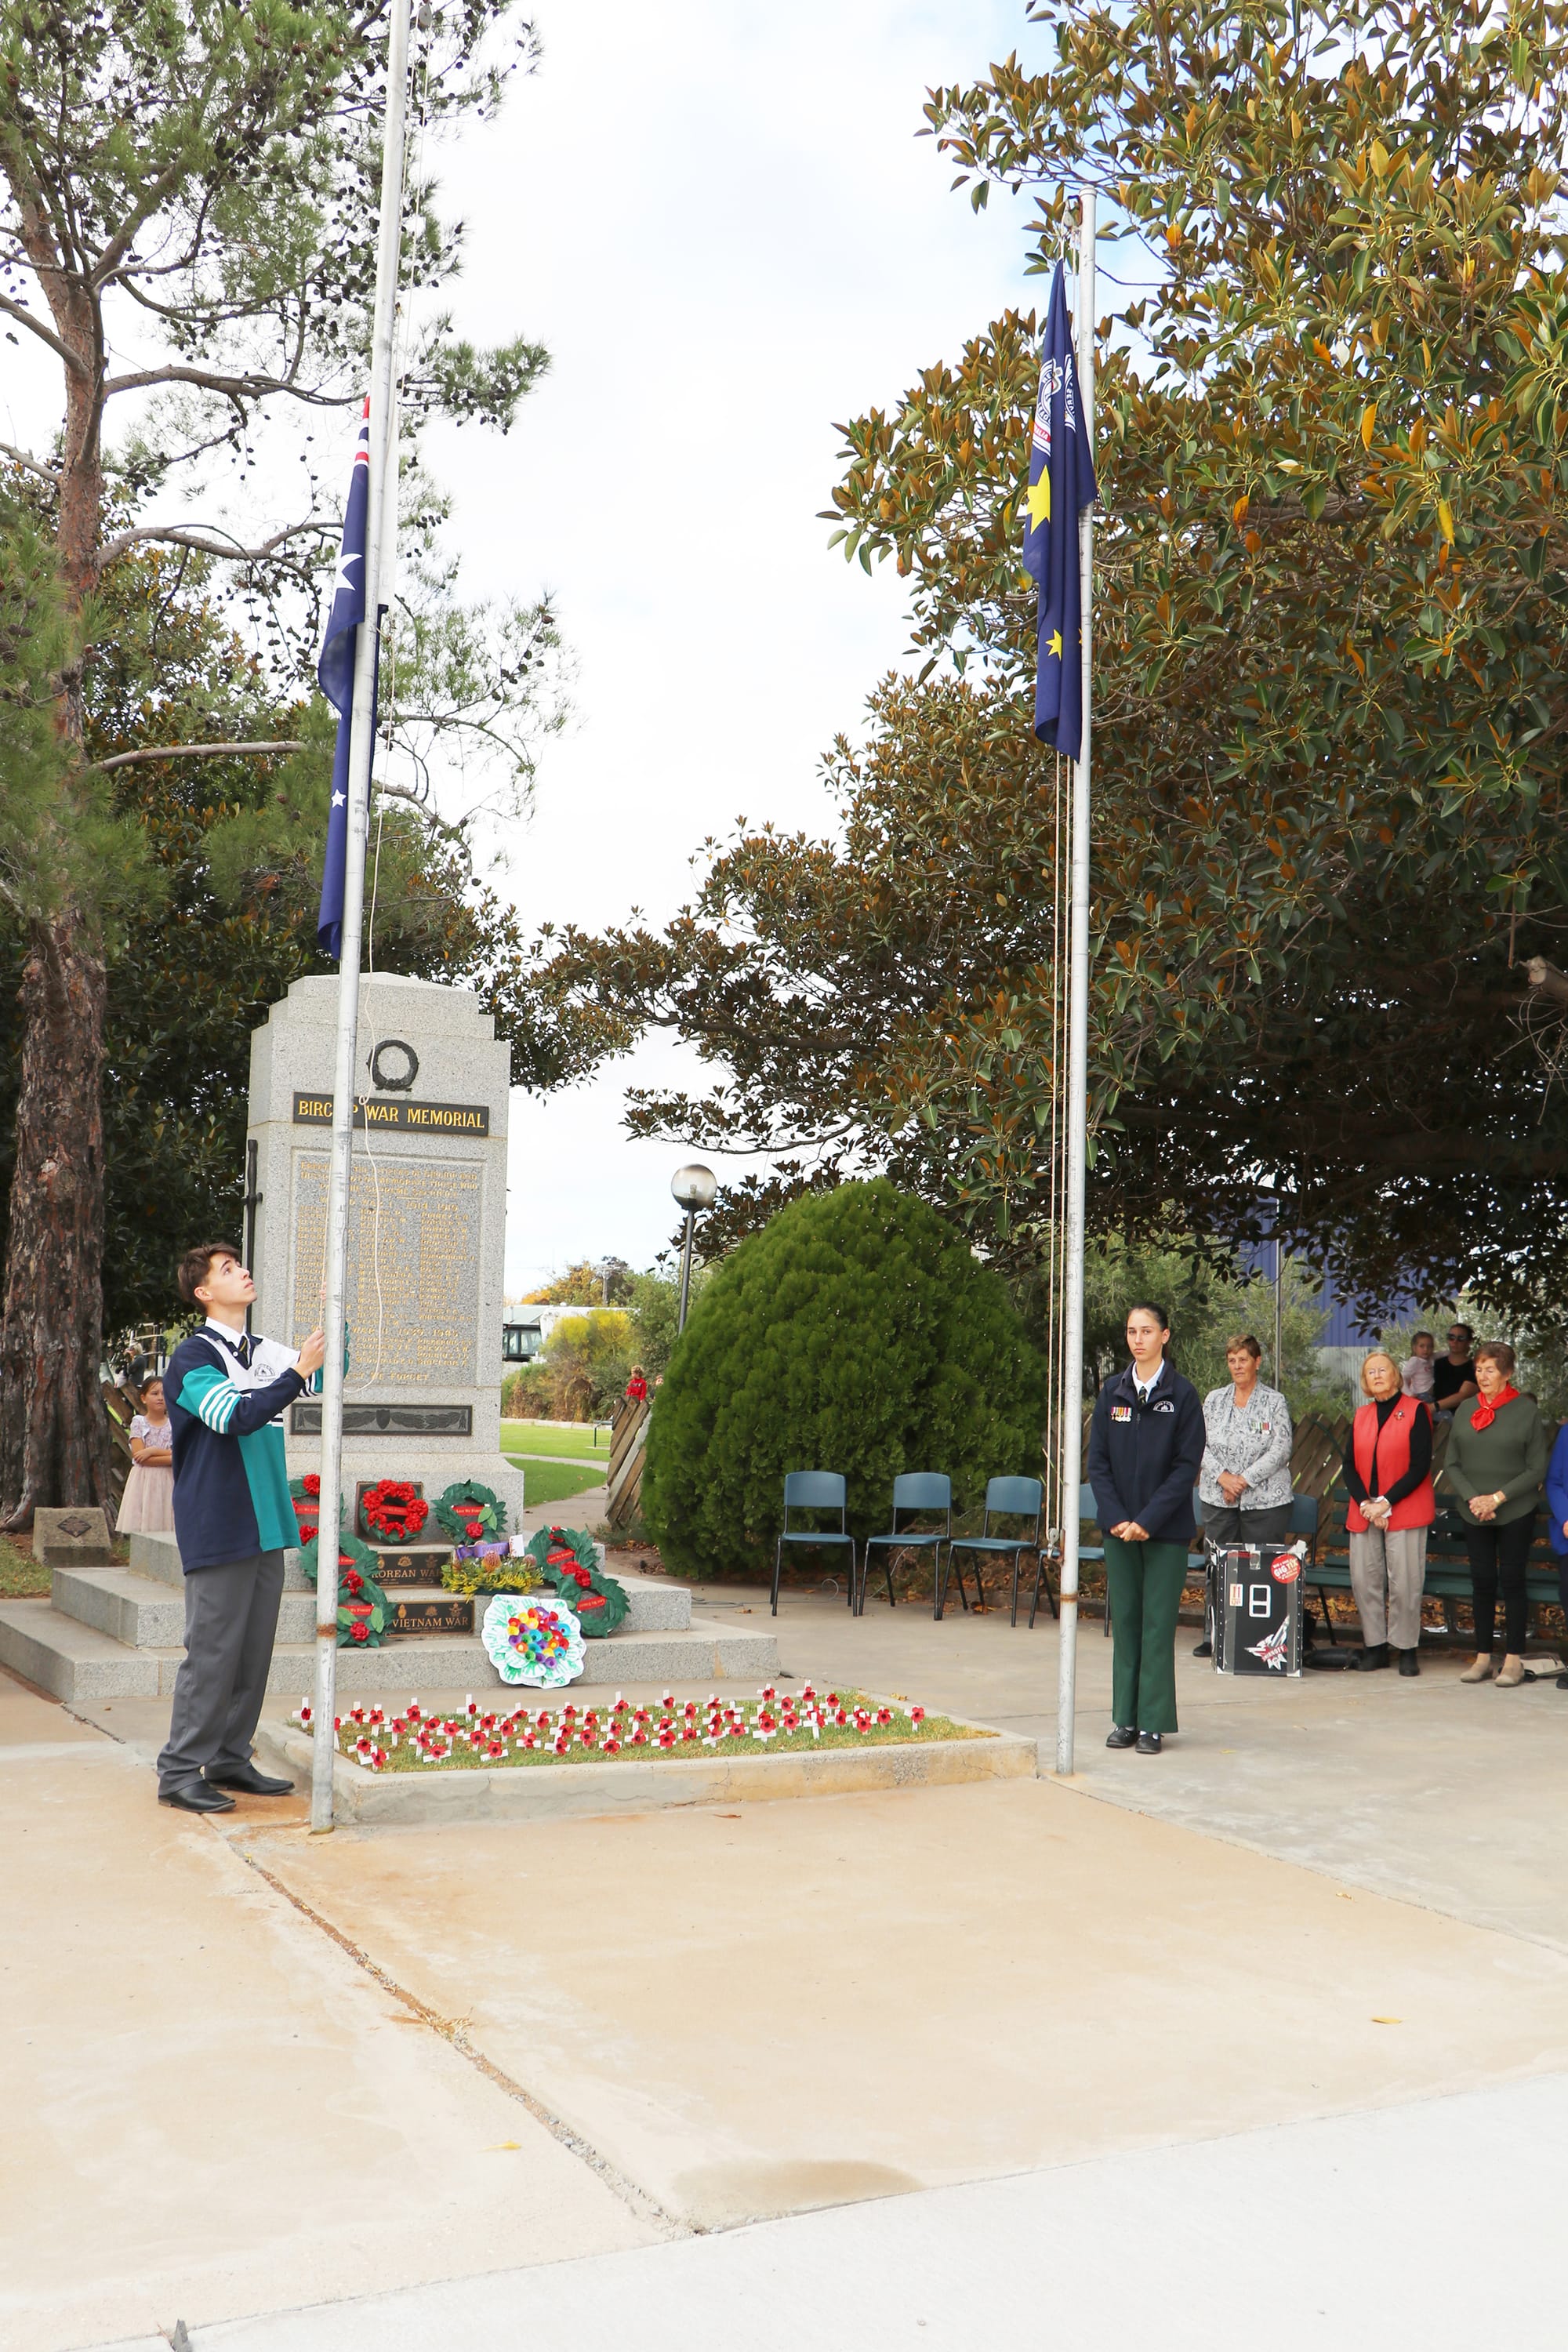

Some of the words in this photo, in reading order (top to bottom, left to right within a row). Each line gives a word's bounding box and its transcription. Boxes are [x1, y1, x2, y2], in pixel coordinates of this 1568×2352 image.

[299, 1100, 359, 1118] BIRCP
[365, 1104, 399, 1123] WAR
[407, 1107, 485, 1129] MEMORIAL
[392, 1617, 442, 1628] VIETNAM
[445, 1617, 469, 1627] WAR
